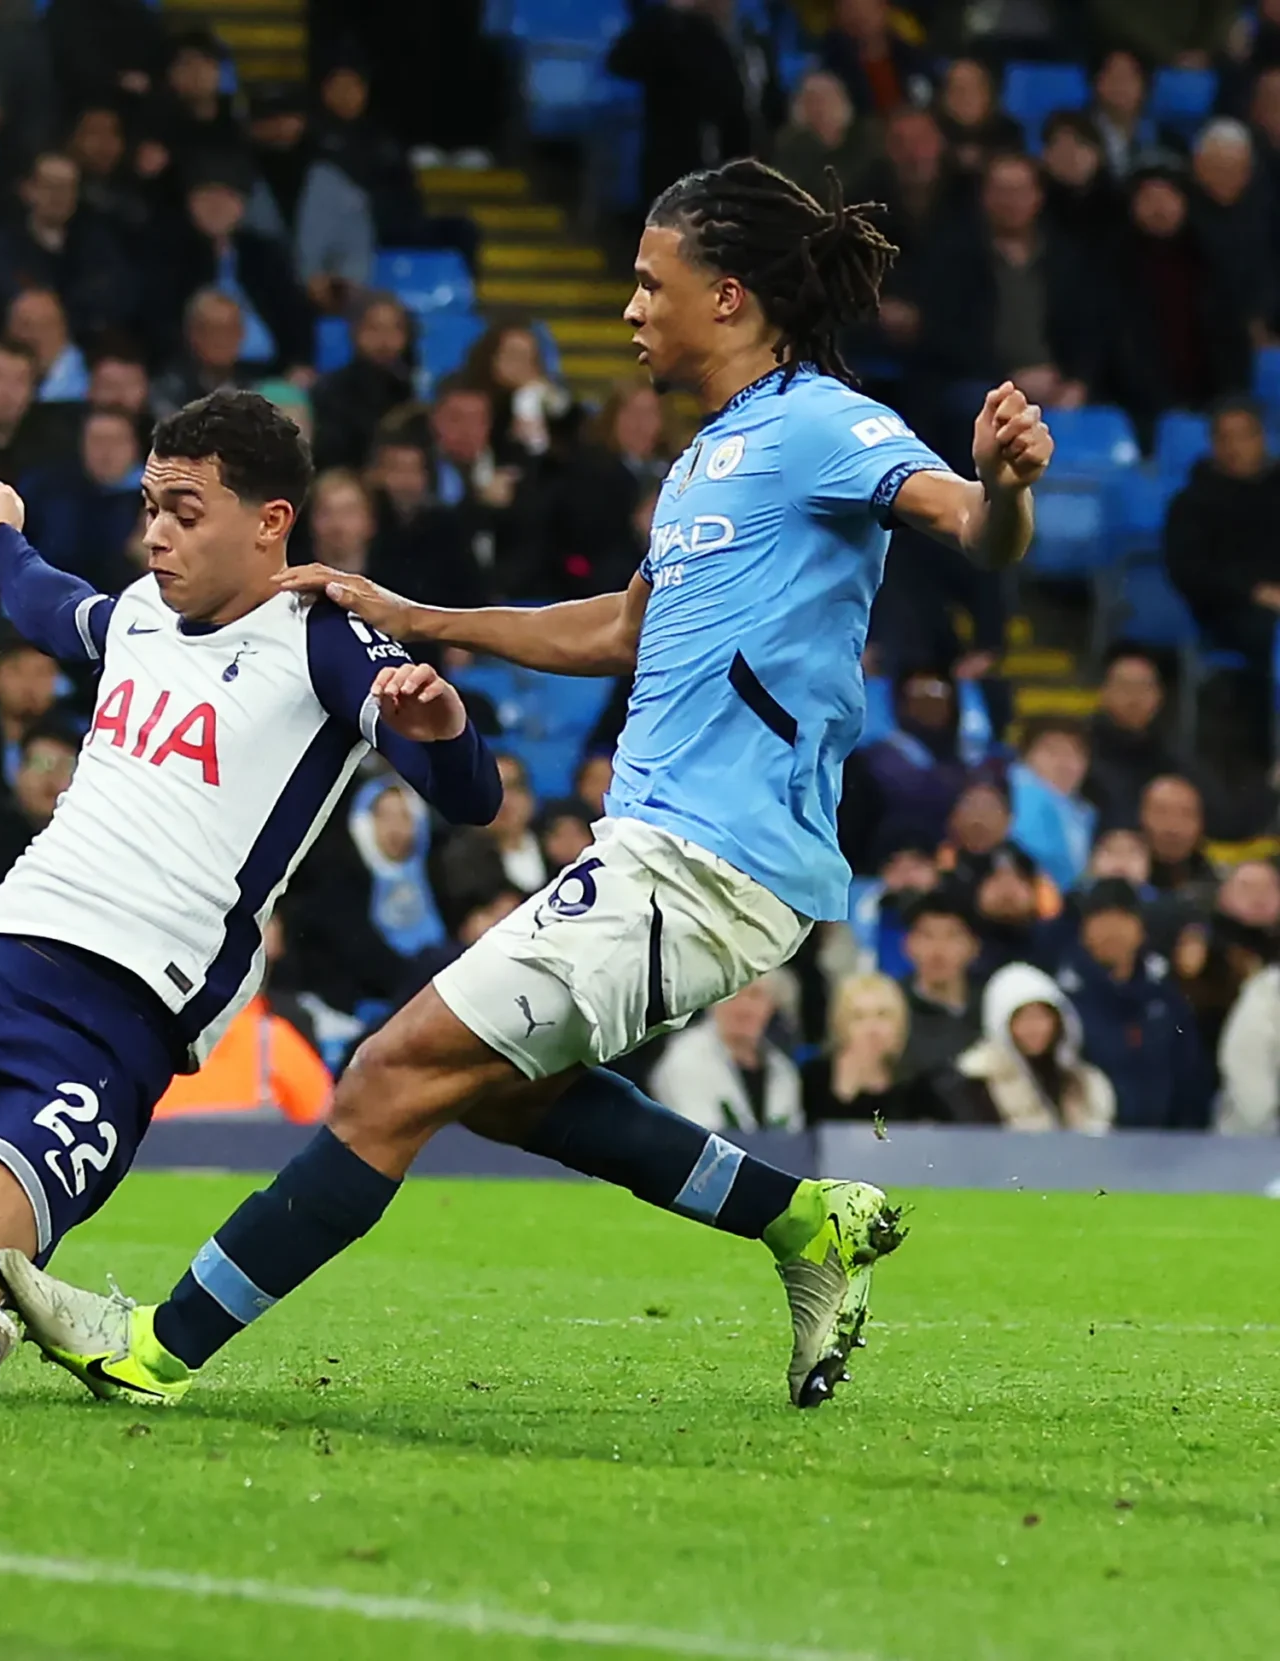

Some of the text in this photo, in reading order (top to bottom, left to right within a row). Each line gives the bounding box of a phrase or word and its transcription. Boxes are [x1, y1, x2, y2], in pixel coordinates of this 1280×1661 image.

[86, 679, 220, 787] AIA
[548, 857, 605, 916] 6
[33, 1081, 118, 1196] 22
